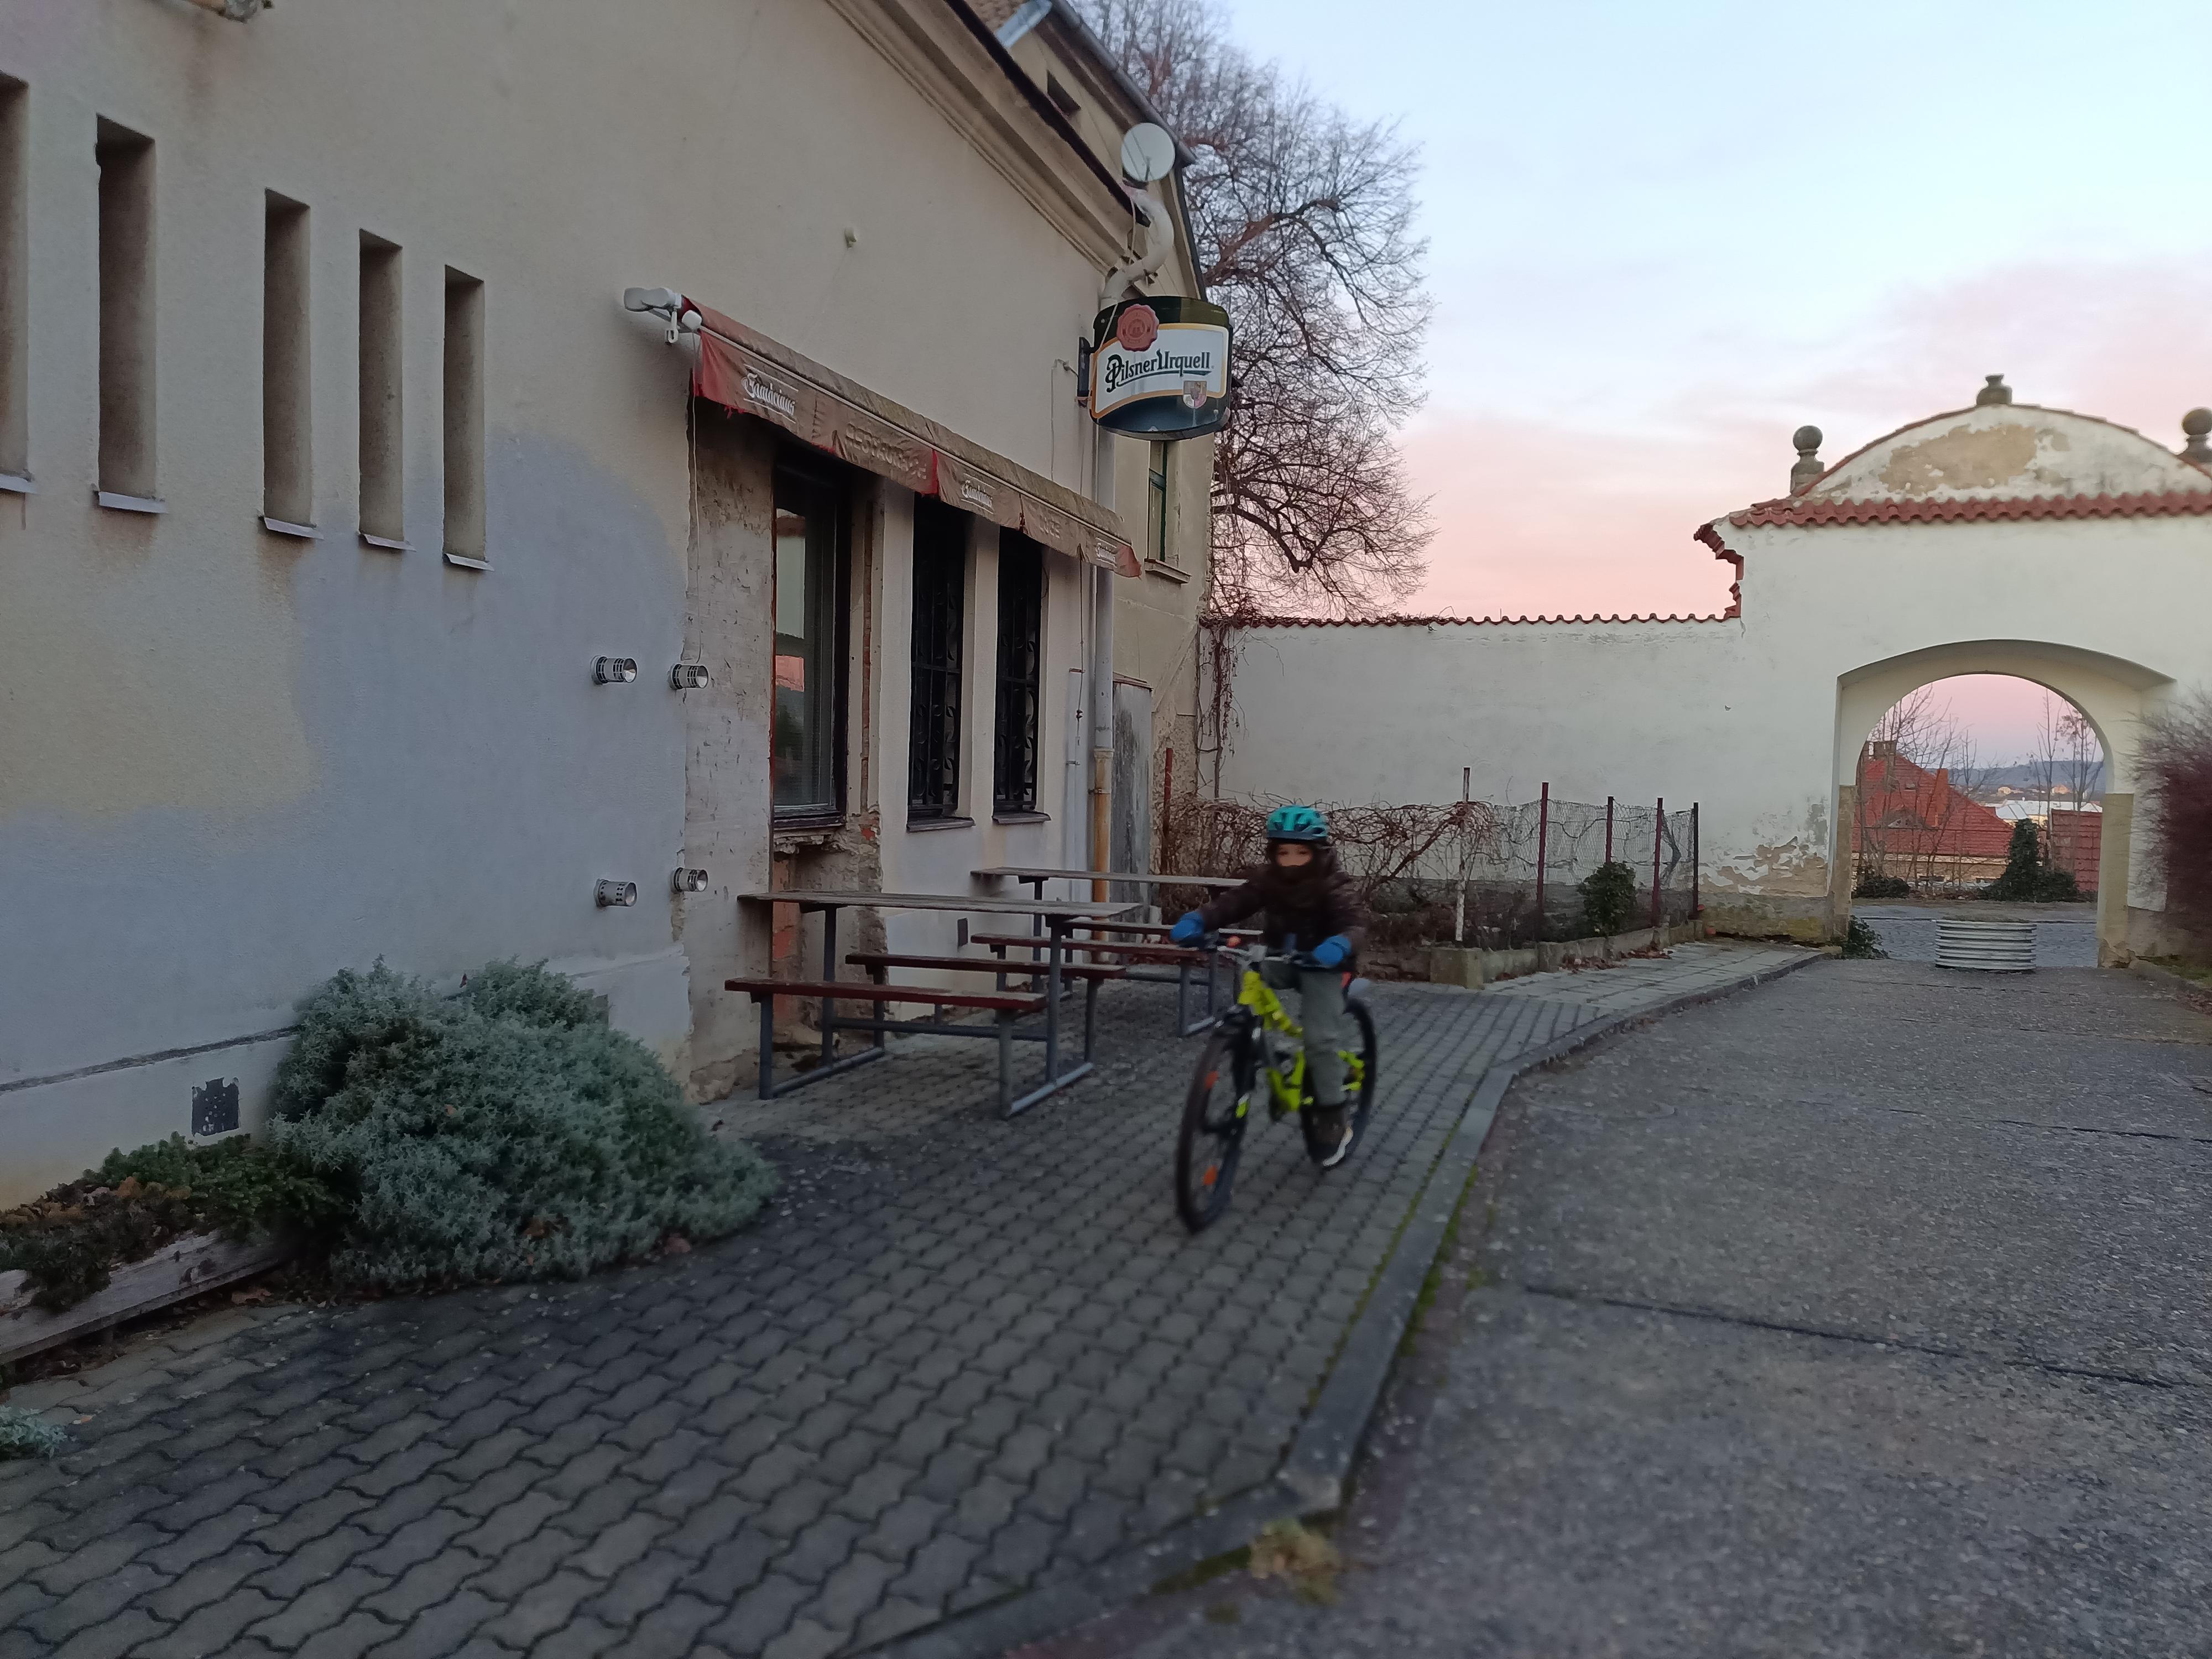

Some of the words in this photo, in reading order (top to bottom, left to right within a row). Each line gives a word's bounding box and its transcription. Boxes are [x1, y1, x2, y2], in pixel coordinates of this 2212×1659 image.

[1105, 354, 1157, 393] Pilsner
[1156, 348, 1210, 377] Urquell
[741, 373, 795, 416] Gambrinus
